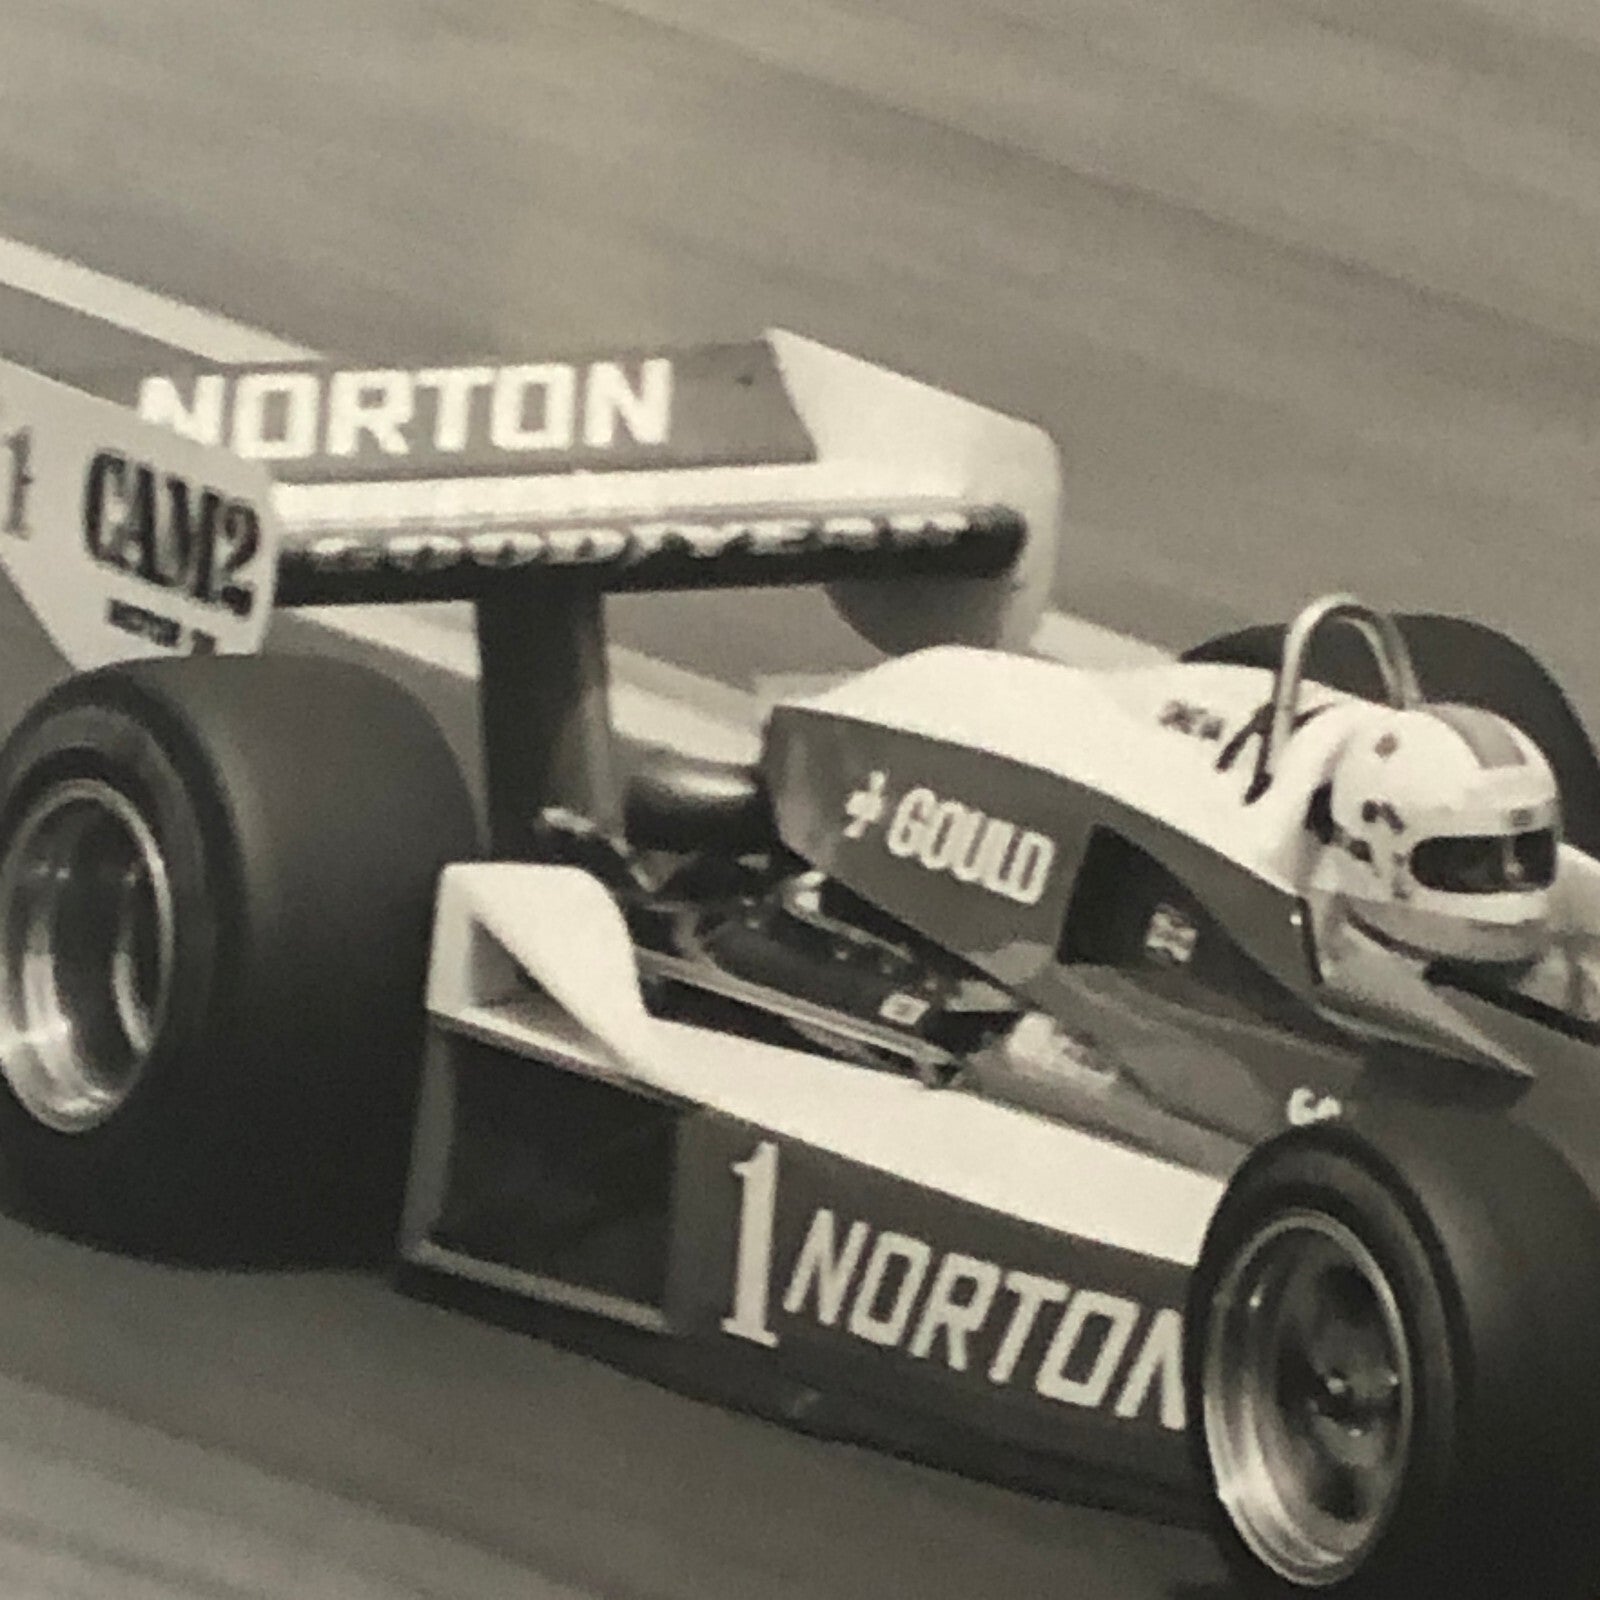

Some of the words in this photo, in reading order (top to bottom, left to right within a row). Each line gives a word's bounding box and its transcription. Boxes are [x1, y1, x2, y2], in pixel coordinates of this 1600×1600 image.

[138, 358, 675, 459] NORTON
[82, 448, 261, 618] CAM2
[886, 787, 1057, 906] GOULD
[720, 1141, 780, 1348] 1
